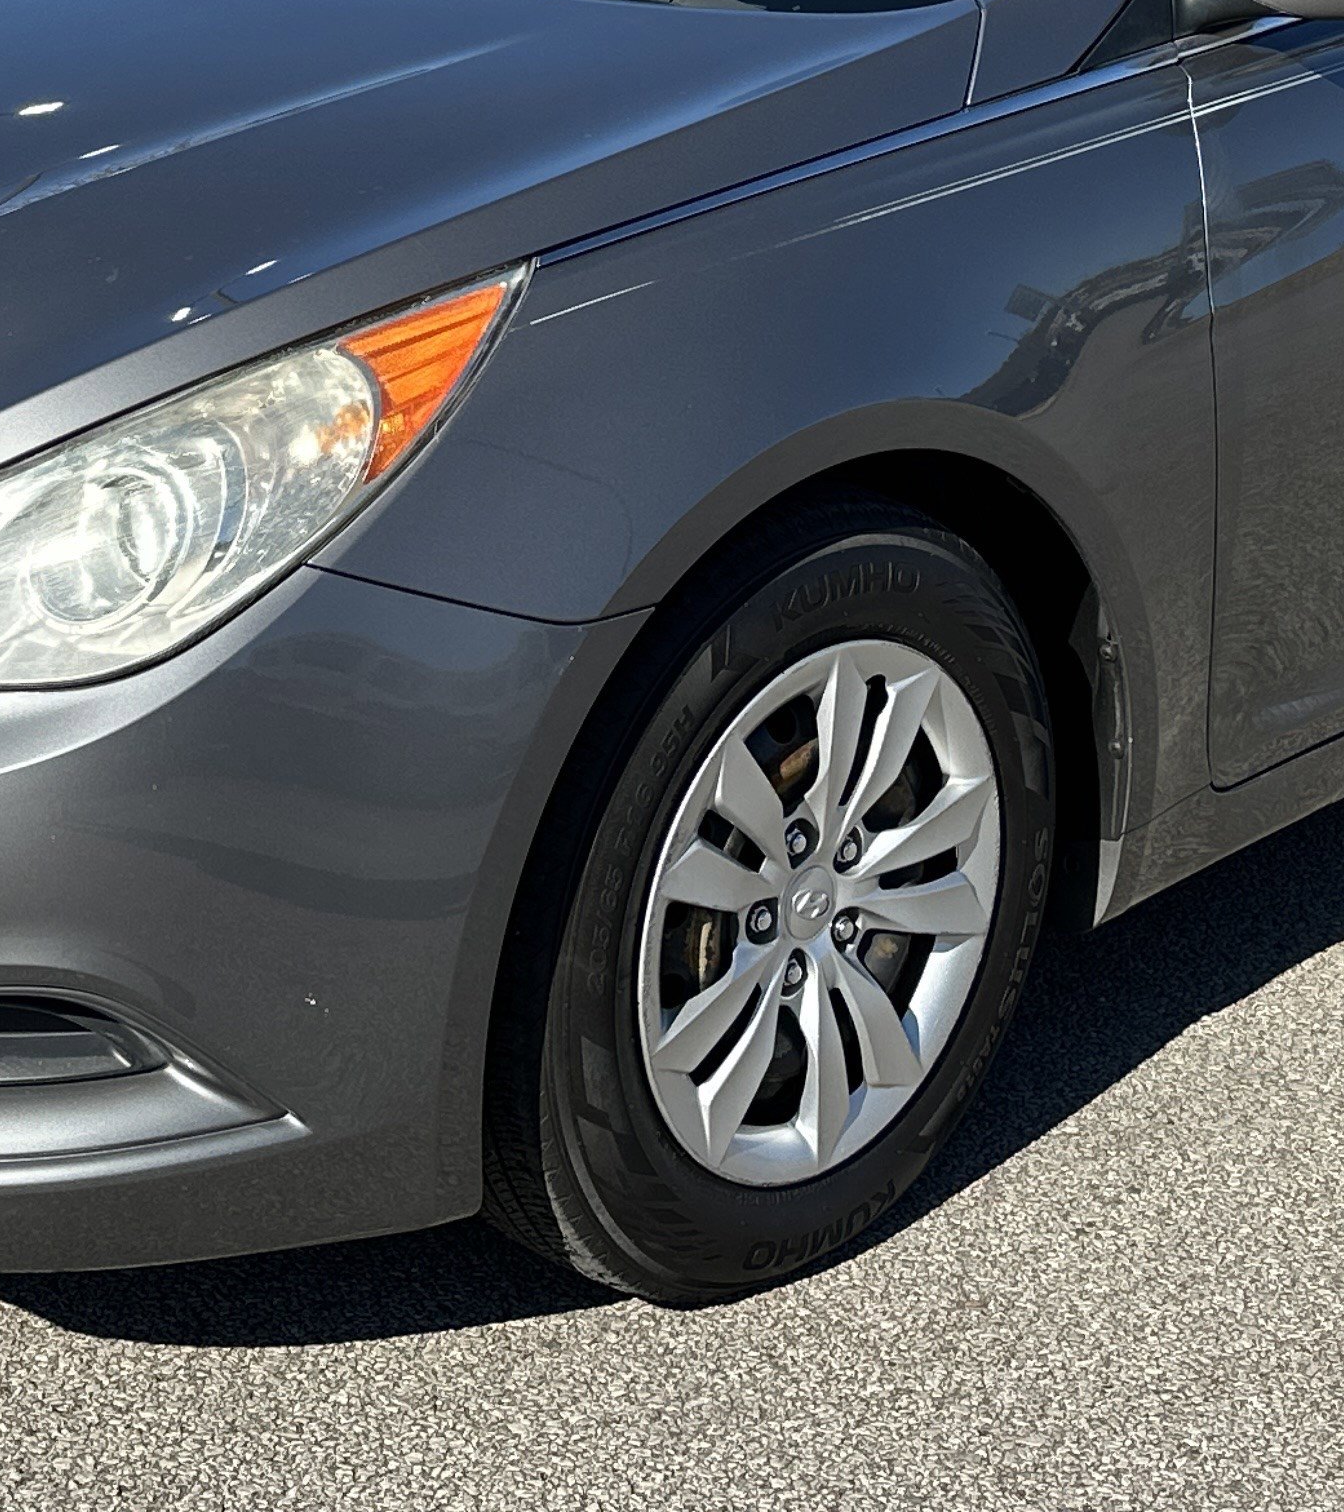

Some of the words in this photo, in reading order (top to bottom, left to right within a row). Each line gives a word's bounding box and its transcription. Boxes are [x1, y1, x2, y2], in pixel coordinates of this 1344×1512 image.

[768, 560, 922, 634] KUMHO
[586, 863, 625, 997] 205/65
[648, 704, 696, 779] 95H
[997, 825, 1050, 1022] SOLUS
[742, 1178, 897, 1271] KUMHO
